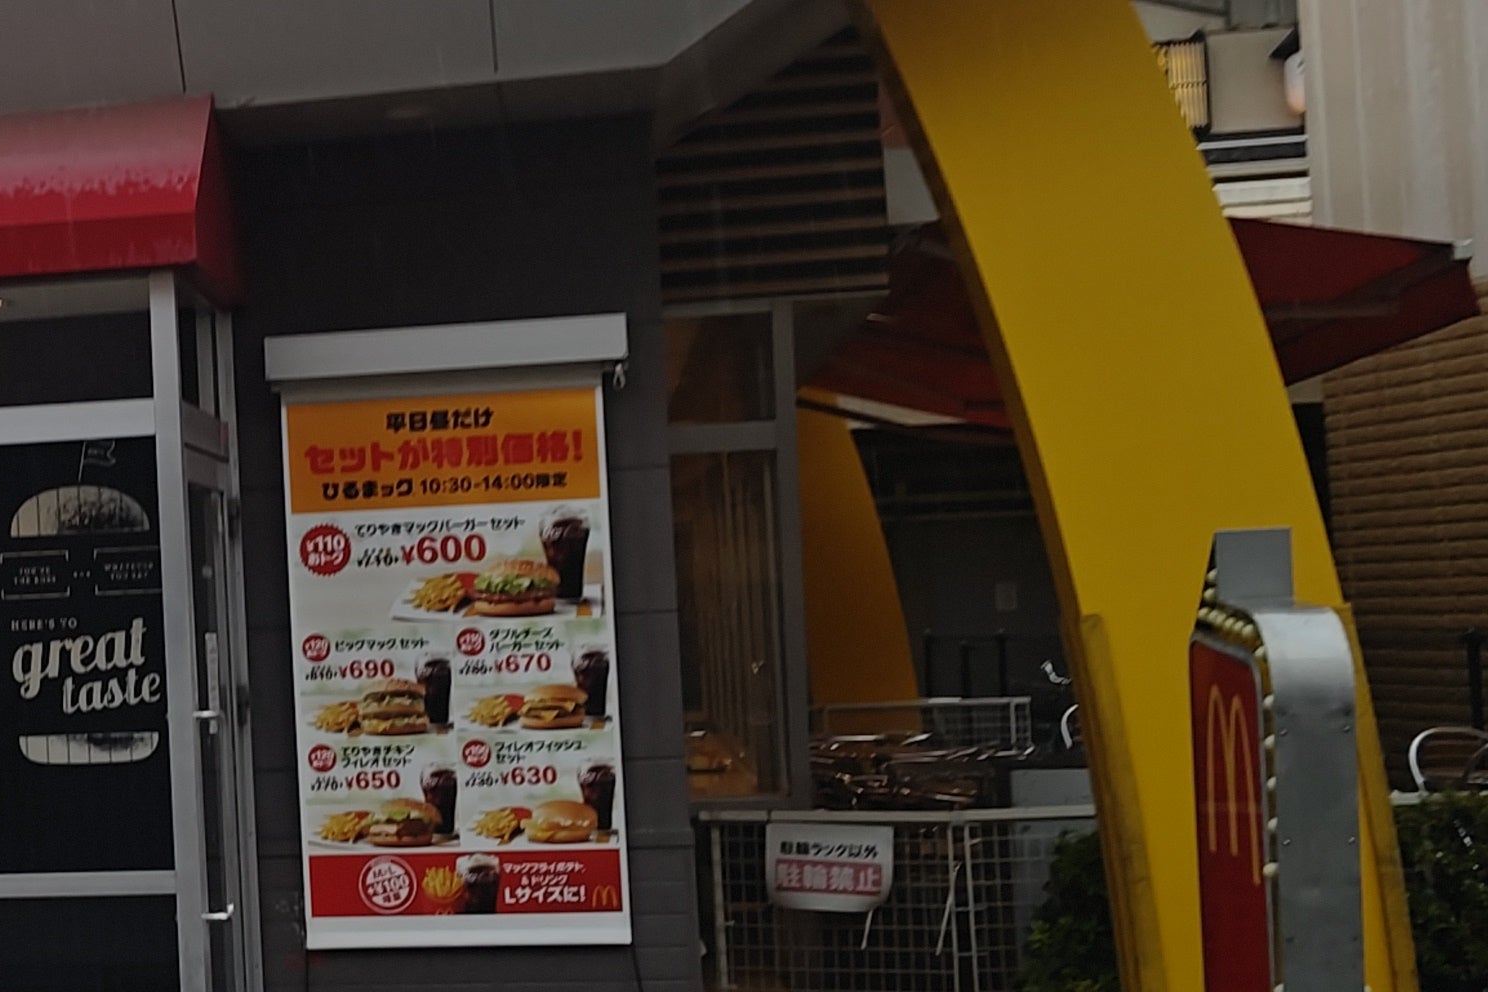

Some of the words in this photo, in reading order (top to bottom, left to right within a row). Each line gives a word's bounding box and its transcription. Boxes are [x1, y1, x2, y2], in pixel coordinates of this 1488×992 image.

[385, 407, 494, 433] 平日昼だけ
[401, 534, 487, 566] ¥600
[12, 617, 147, 700] great
[338, 659, 395, 680] ¥690
[494, 654, 552, 674] ¥670
[62, 668, 161, 714] taste
[344, 770, 401, 791] ¥650
[500, 766, 558, 786] ¥630
